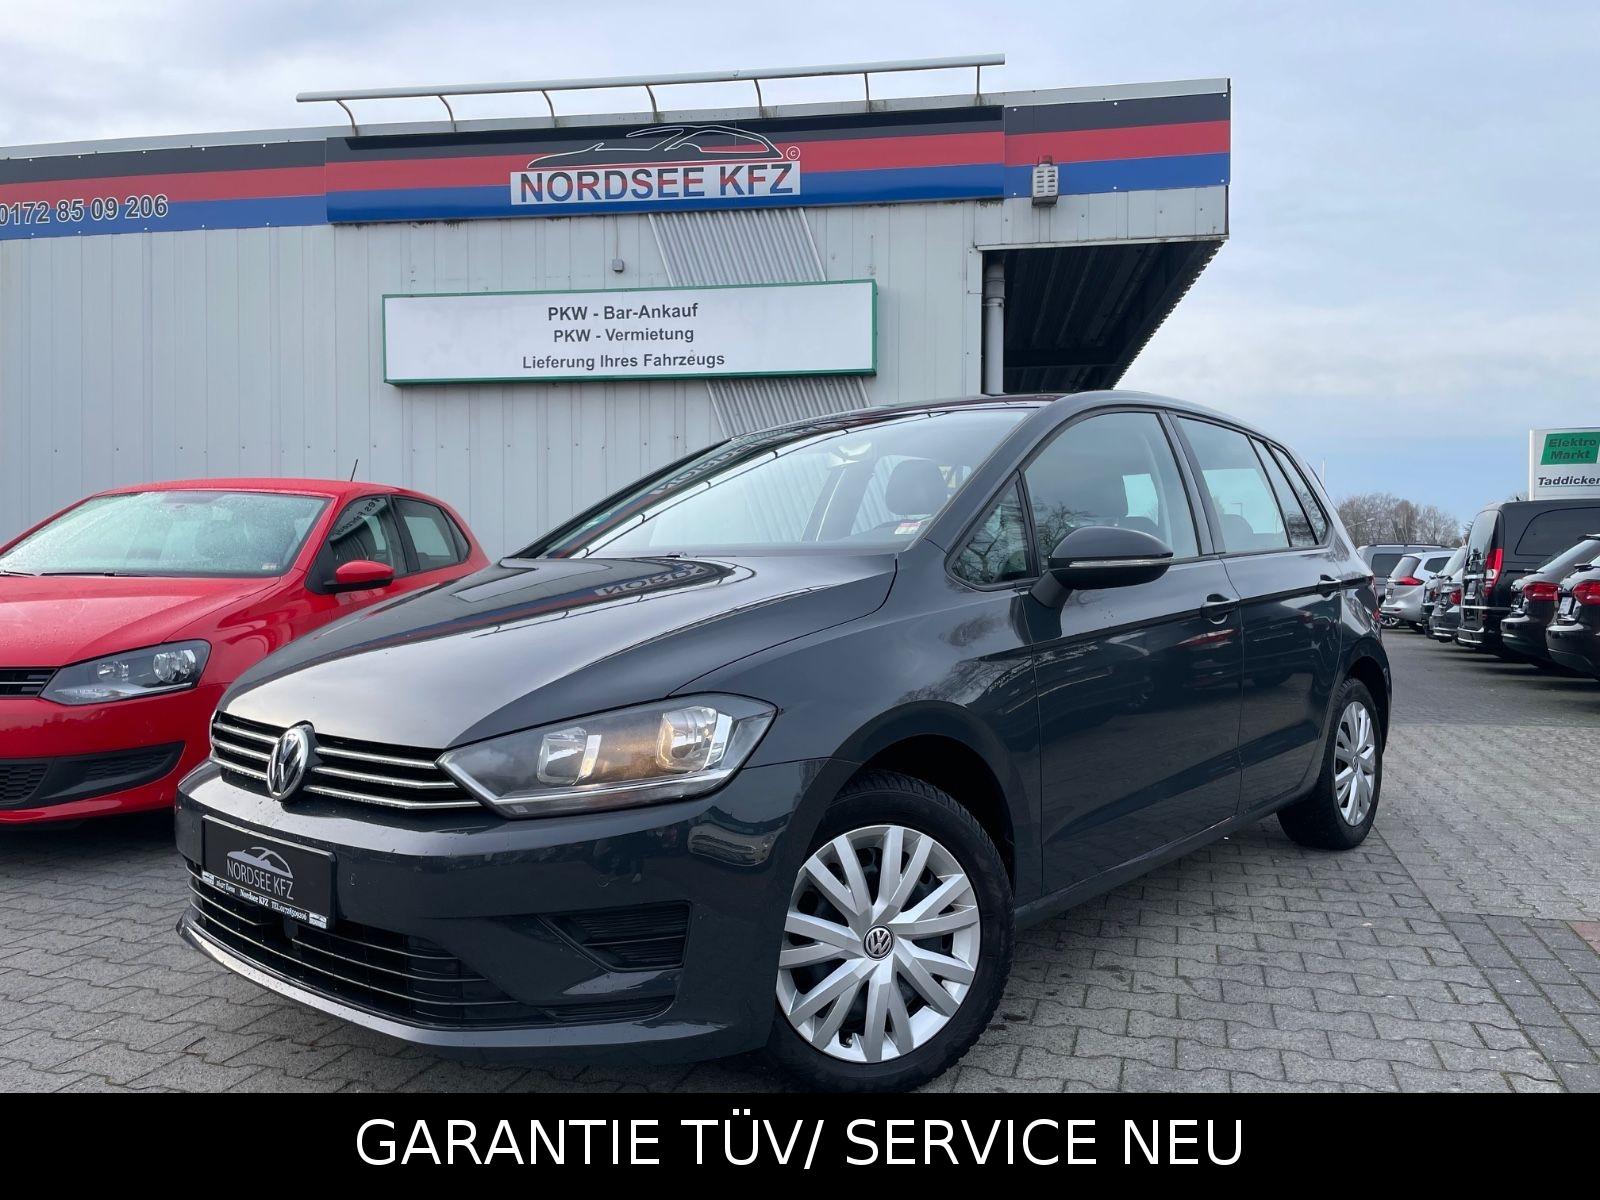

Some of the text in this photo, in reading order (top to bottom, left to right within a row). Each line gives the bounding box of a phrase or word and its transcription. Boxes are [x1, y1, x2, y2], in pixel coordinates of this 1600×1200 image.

[520, 162, 793, 203] NORDSEE KFZ
[56, 198, 85, 223] 85
[91, 196, 119, 222] 09
[125, 194, 169, 219] 206
[548, 306, 588, 321] PKW
[604, 302, 699, 320] Bar-Ankauf
[553, 329, 591, 343] PKW
[605, 327, 694, 343] Vermietung
[522, 352, 726, 371] Lieferung Ihres Fahrzeugs
[1548, 437, 1597, 448] Elektro
[1550, 450, 1590, 460] Markt
[226, 858, 272, 892] NORDSEE
[273, 877, 294, 901] KFZ
